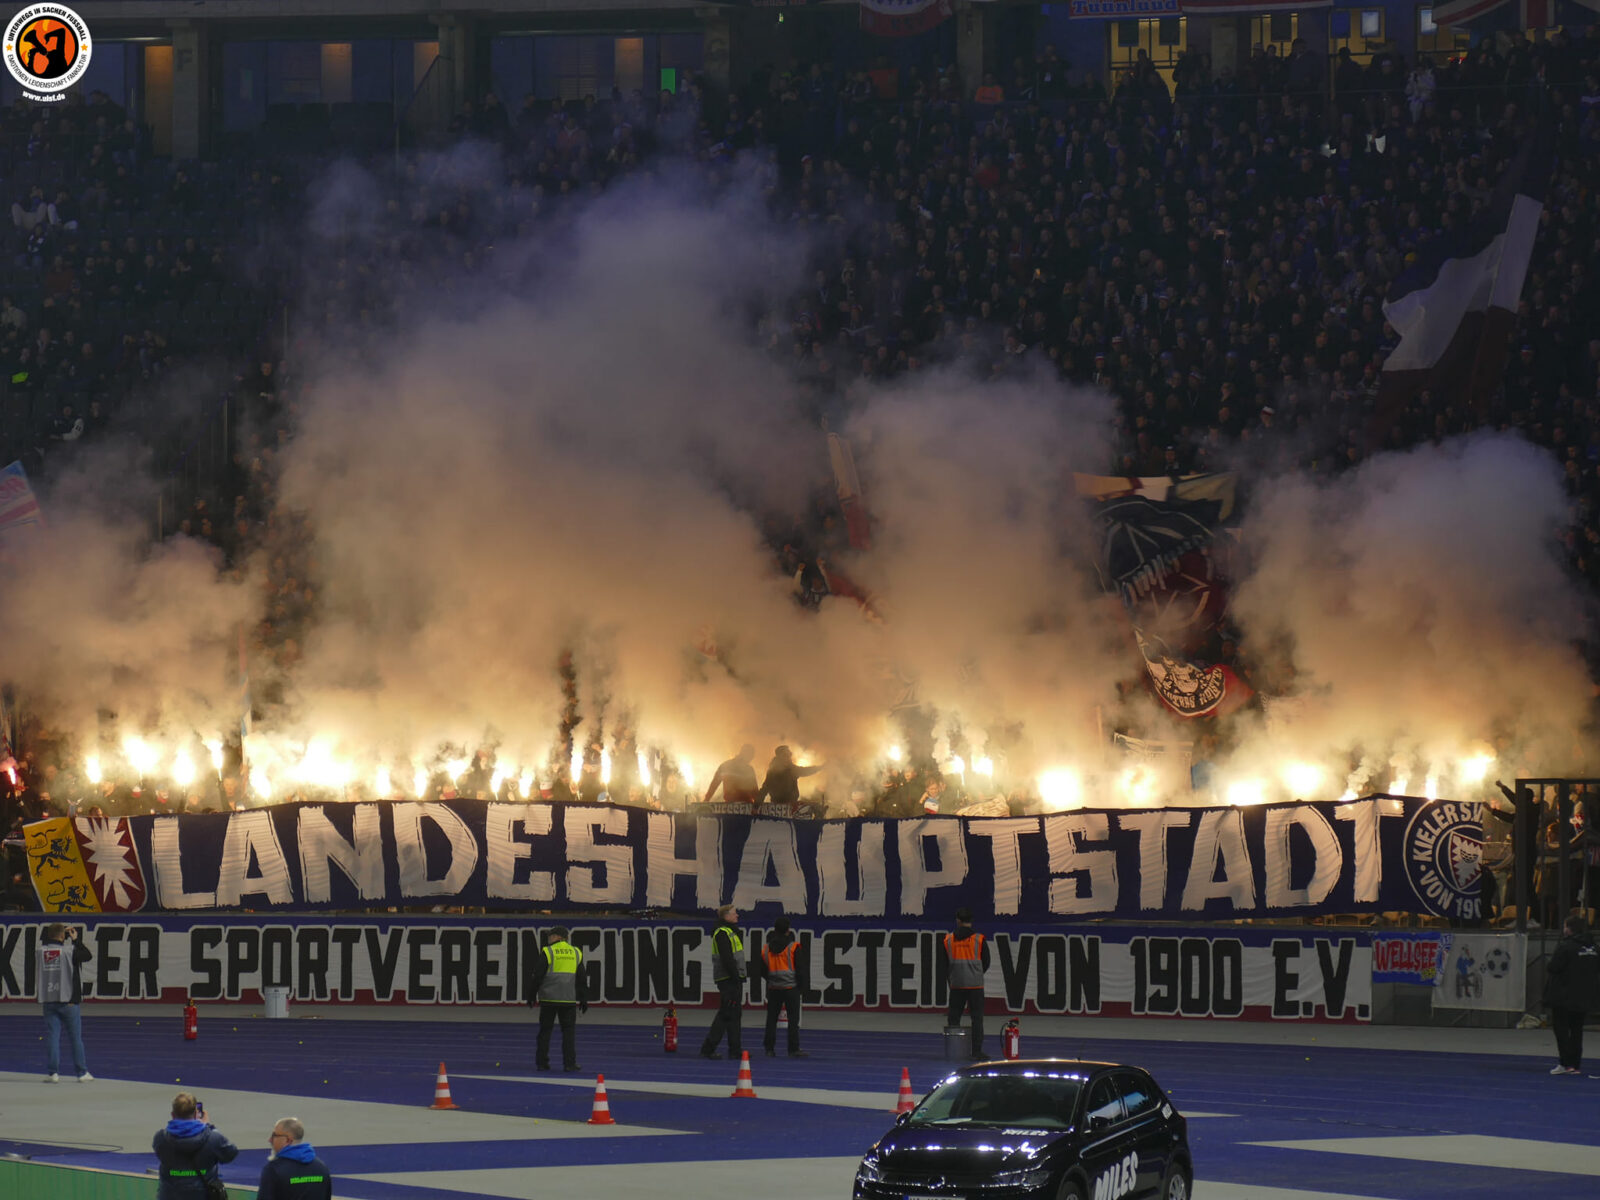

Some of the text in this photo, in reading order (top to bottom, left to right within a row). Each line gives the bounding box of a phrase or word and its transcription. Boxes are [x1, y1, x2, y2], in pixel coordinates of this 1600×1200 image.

[1412, 803, 1459, 862] KIELER
[151, 798, 1404, 918] LANDESHAUPTSTADT
[1420, 870, 1454, 910] VON
[0, 923, 160, 999] KIER
[190, 924, 703, 1004] SPORTVEREINGUNG
[993, 932, 1101, 1013] VON
[1130, 936, 1244, 1017] 1900
[1271, 937, 1372, 1021] E.V.
[1374, 940, 1438, 971] WELLSEE
[1001, 1128, 1049, 1137] MILES
[1094, 1151, 1139, 1200] MILES
